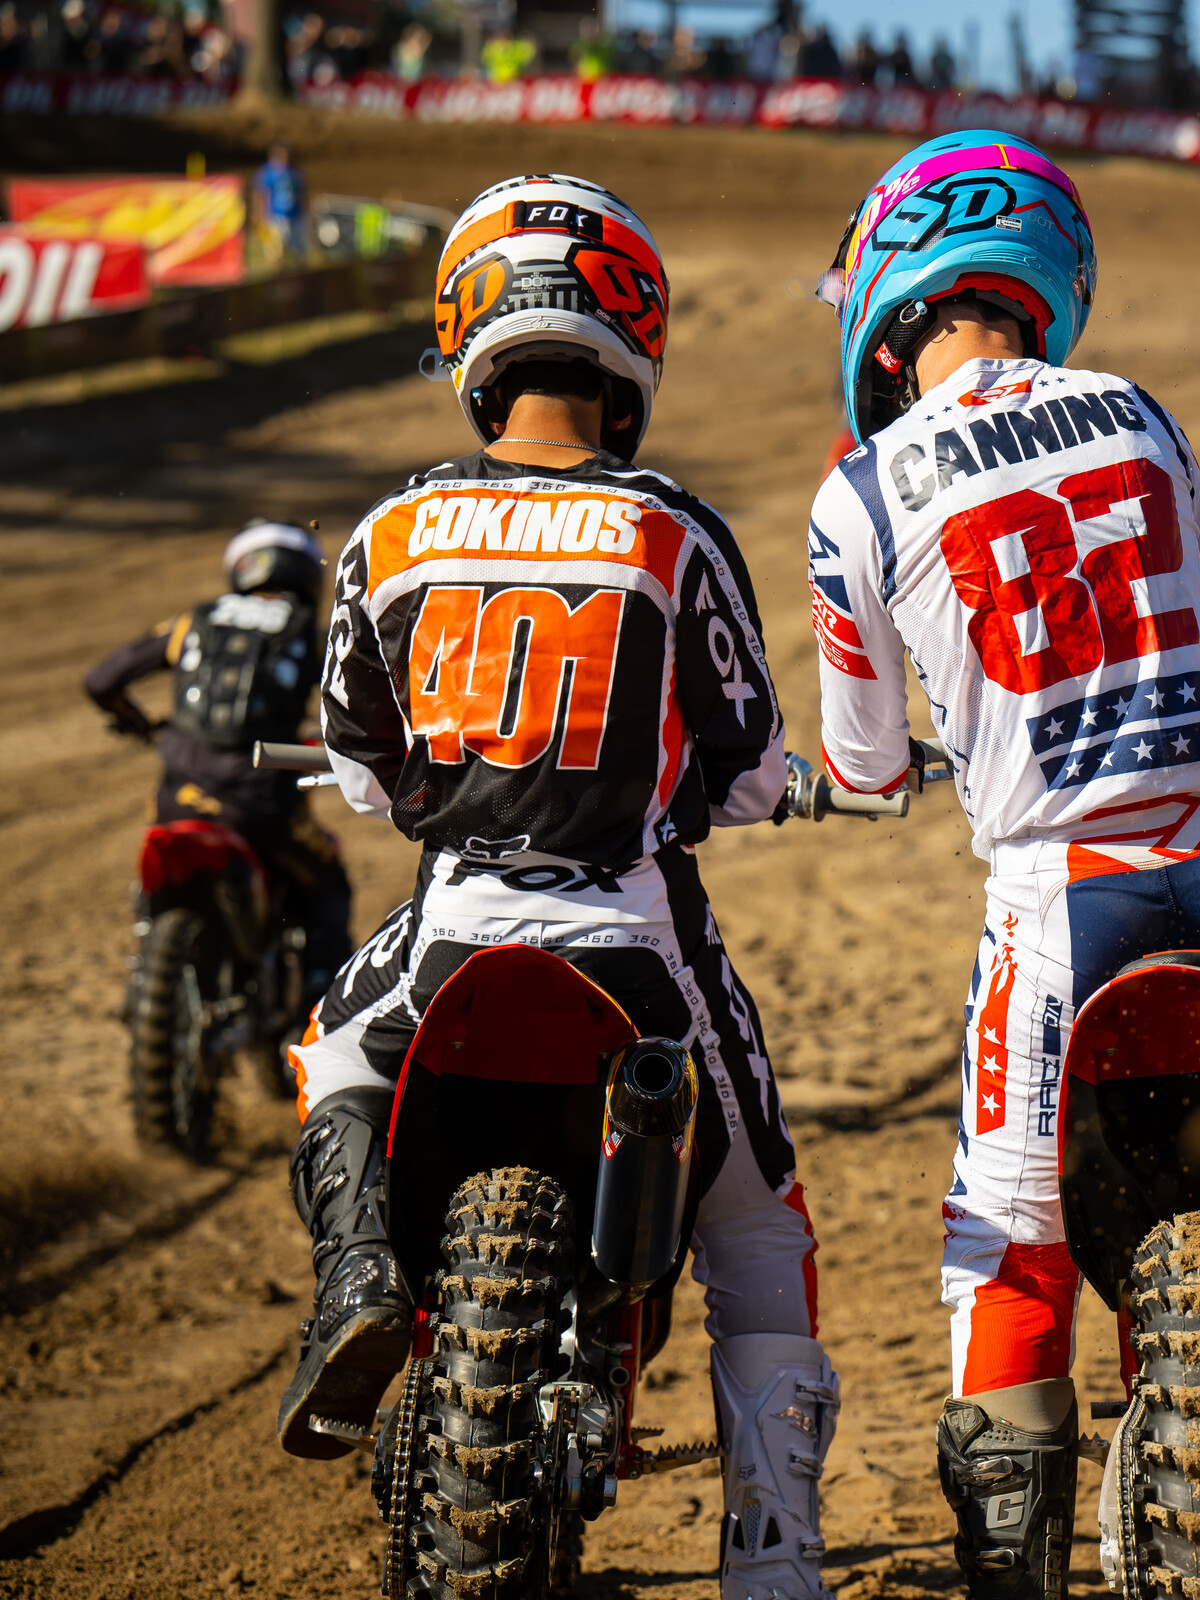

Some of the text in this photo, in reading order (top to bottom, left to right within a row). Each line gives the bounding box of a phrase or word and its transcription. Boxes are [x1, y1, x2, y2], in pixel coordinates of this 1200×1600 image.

[889, 390, 1147, 512] CANNING
[530, 481, 566, 492] 360
[408, 496, 642, 557] COKINOS
[940, 457, 1199, 696] 82
[408, 585, 627, 770] 401
[695, 570, 758, 730] FOX
[446, 858, 642, 894] FOX
[433, 928, 455, 938] 360
[470, 932, 502, 943] 360
[581, 934, 614, 944] 360
[629, 935, 660, 947] 360
[986, 1490, 1026, 1529] G
